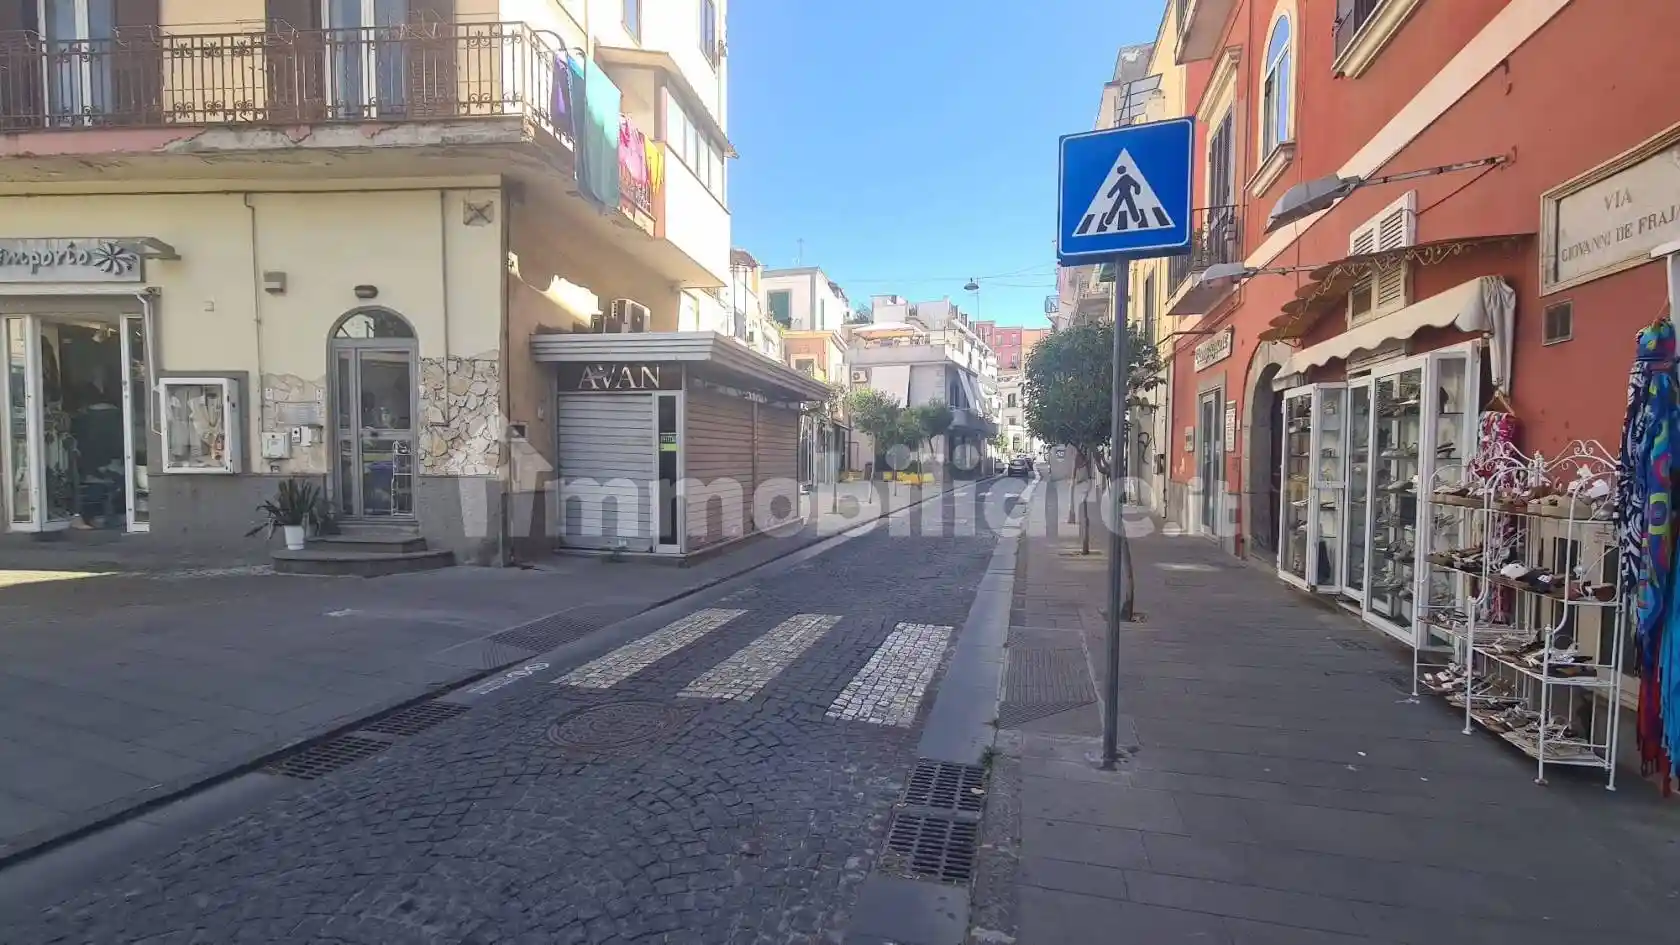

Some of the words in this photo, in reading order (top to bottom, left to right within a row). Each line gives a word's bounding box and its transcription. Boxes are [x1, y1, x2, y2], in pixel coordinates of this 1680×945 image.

[1604, 188, 1632, 211] VIA
[1561, 231, 1611, 262] GIOVANNI
[1616, 222, 1633, 242] DE
